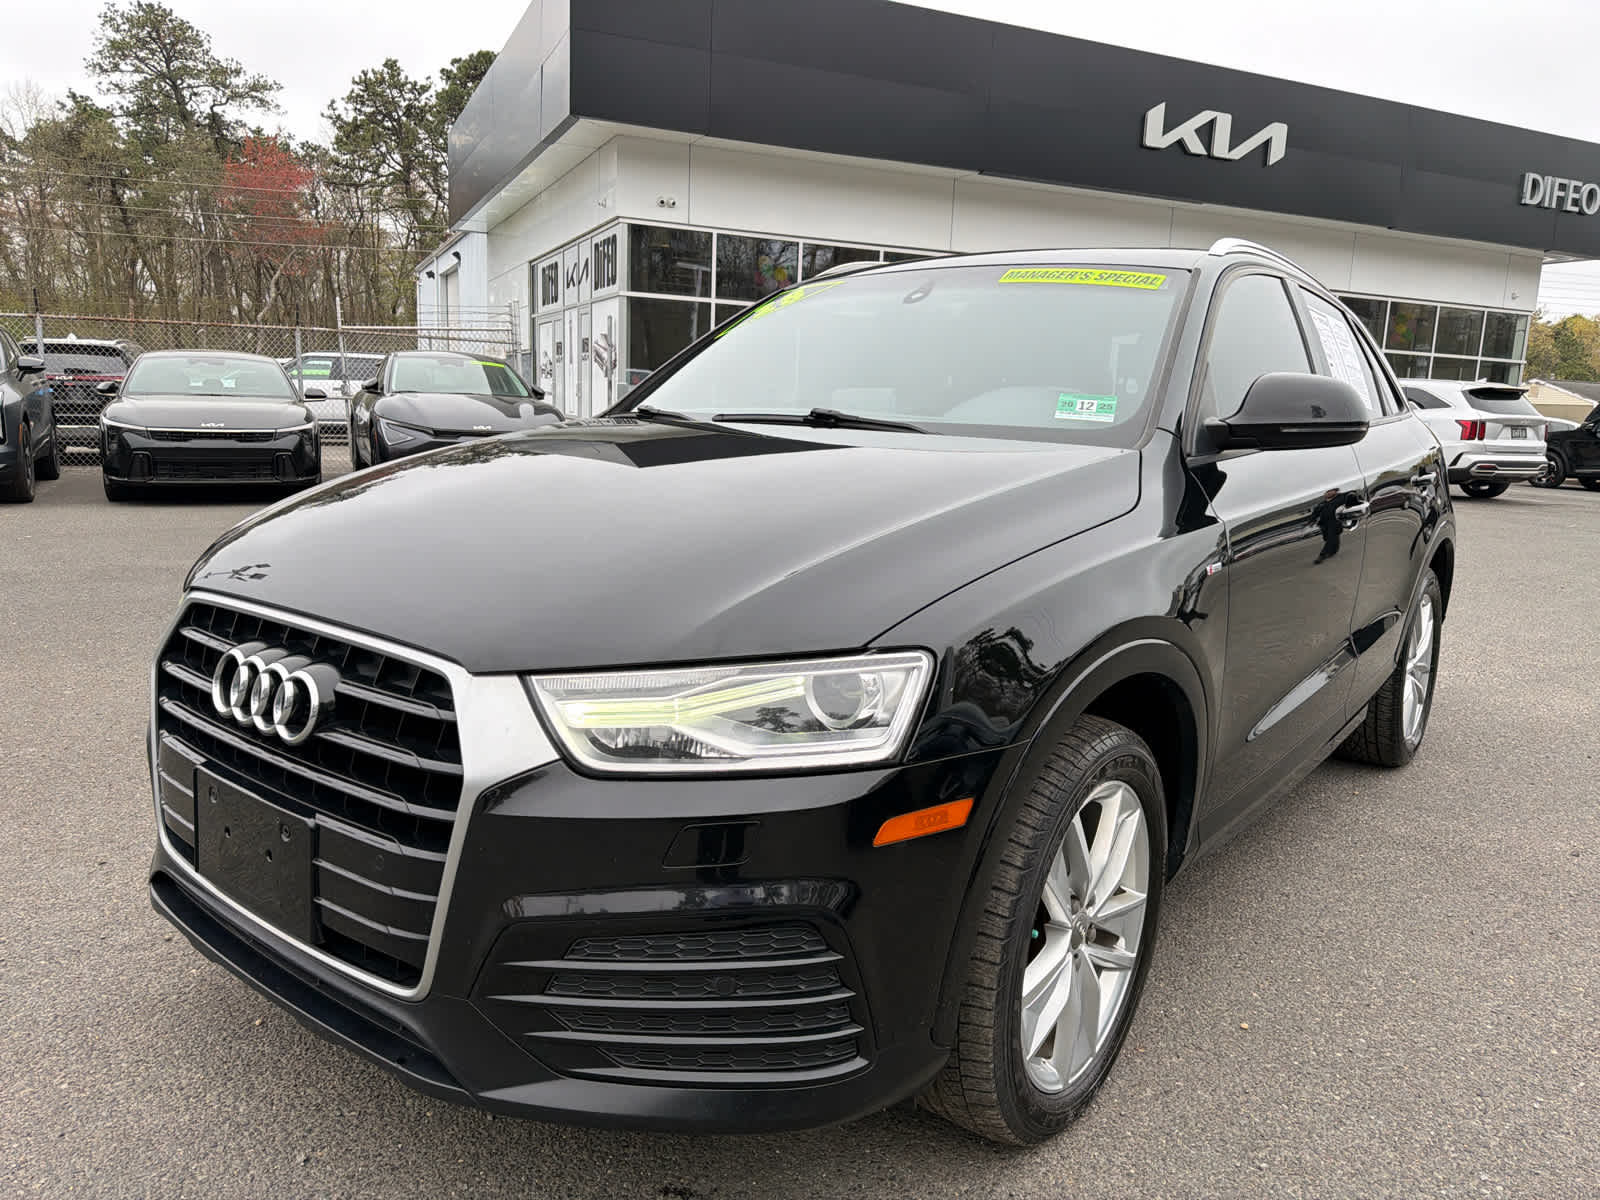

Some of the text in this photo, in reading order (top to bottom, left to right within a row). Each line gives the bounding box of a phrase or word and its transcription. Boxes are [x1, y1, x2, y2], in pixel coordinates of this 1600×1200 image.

[1144, 101, 1288, 167] KIA
[1520, 172, 1600, 215] DIFEO
[1004, 271, 1162, 286] MANAGER'S SPECIAL
[1078, 401, 1095, 411] 12
